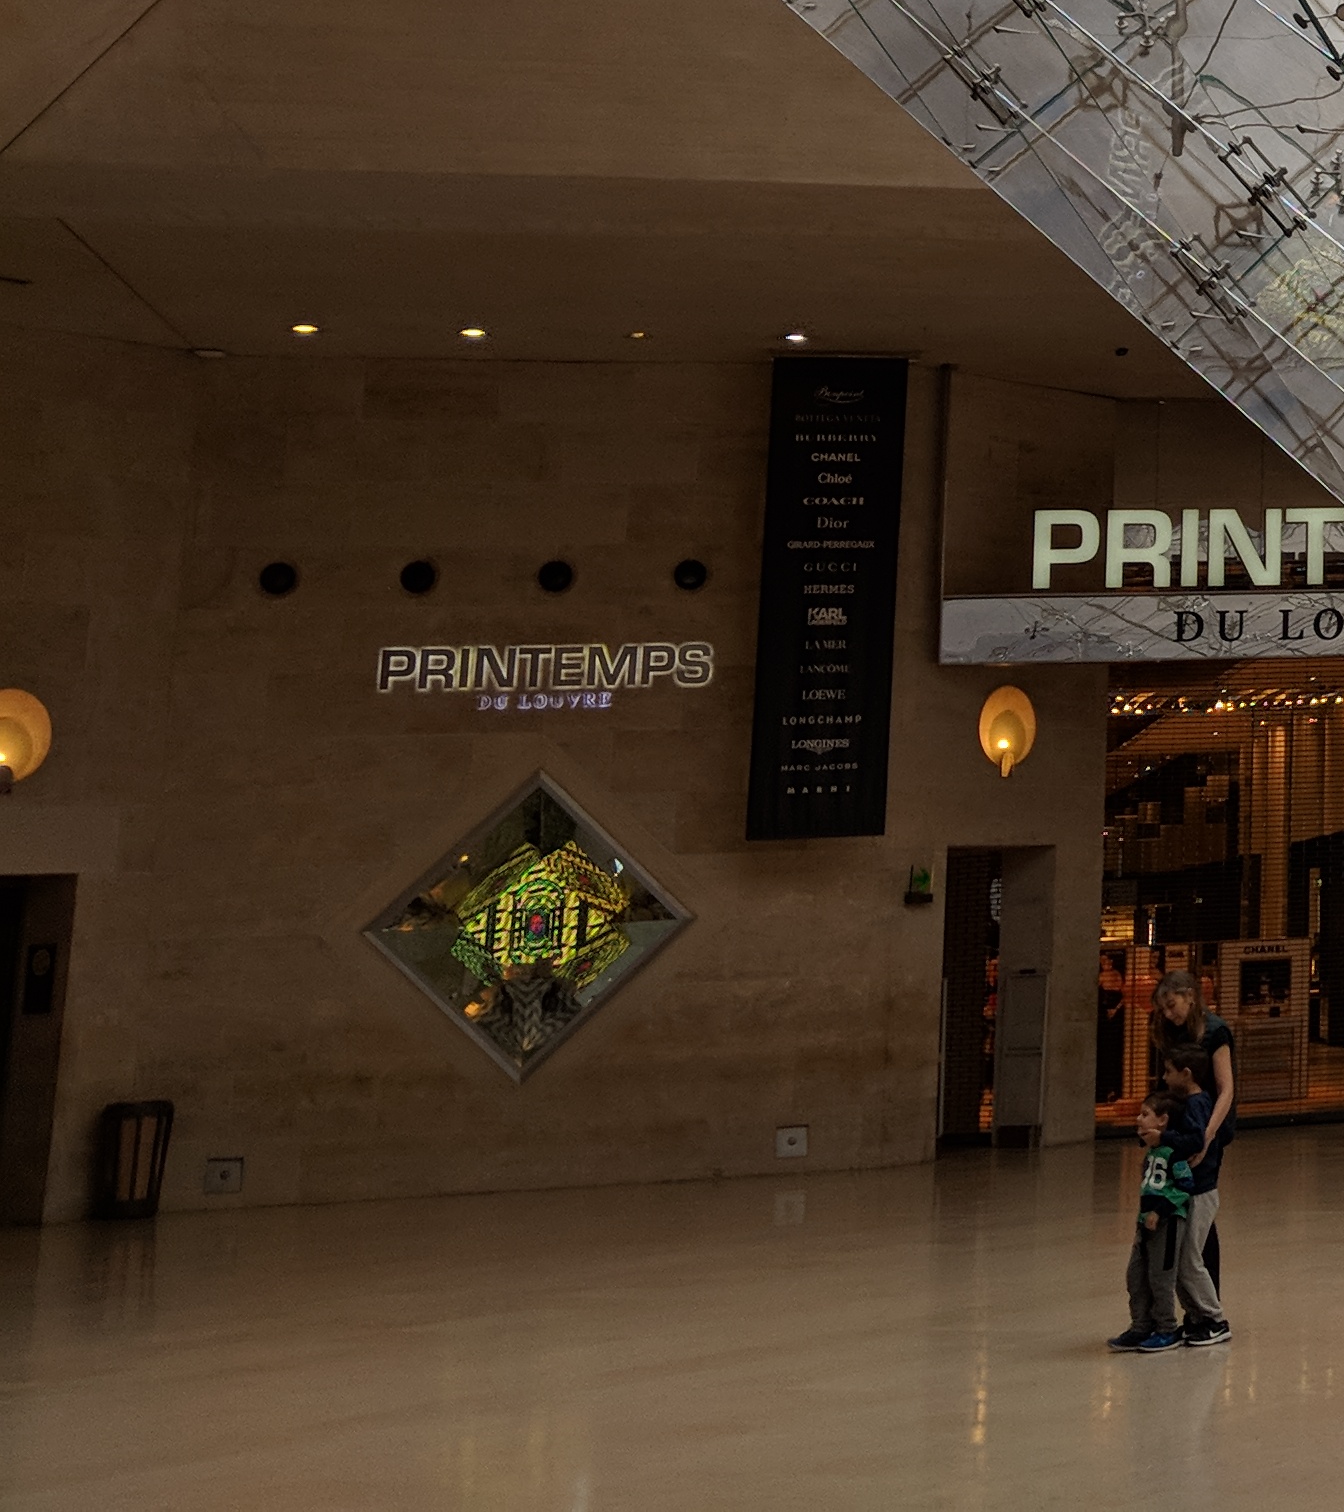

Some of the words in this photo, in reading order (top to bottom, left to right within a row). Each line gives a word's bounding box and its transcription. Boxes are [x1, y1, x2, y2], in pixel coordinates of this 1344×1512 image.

[795, 433, 877, 442] BURBERRY
[810, 452, 862, 463] CHANEL
[817, 471, 853, 484] Chloé
[802, 496, 865, 506] COACH
[816, 516, 850, 529] Dior
[786, 539, 876, 550] GIRARD-PERREGAUX
[803, 561, 858, 572] GUCCI
[807, 606, 848, 621] KARL
[1173, 608, 1246, 643] DU
[805, 639, 821, 650] LA
[377, 641, 714, 693] PRINTEMPS
[799, 663, 851, 674] LANCÔME
[801, 688, 847, 701] LOEWE
[477, 693, 509, 711] DU
[516, 691, 614, 711] LOUVRE
[781, 714, 863, 726] LONGCHAMP
[790, 737, 851, 750] LONGINES
[780, 764, 811, 772] MARC
[814, 761, 860, 772] JACOBS
[1243, 944, 1289, 955] CHANEL
